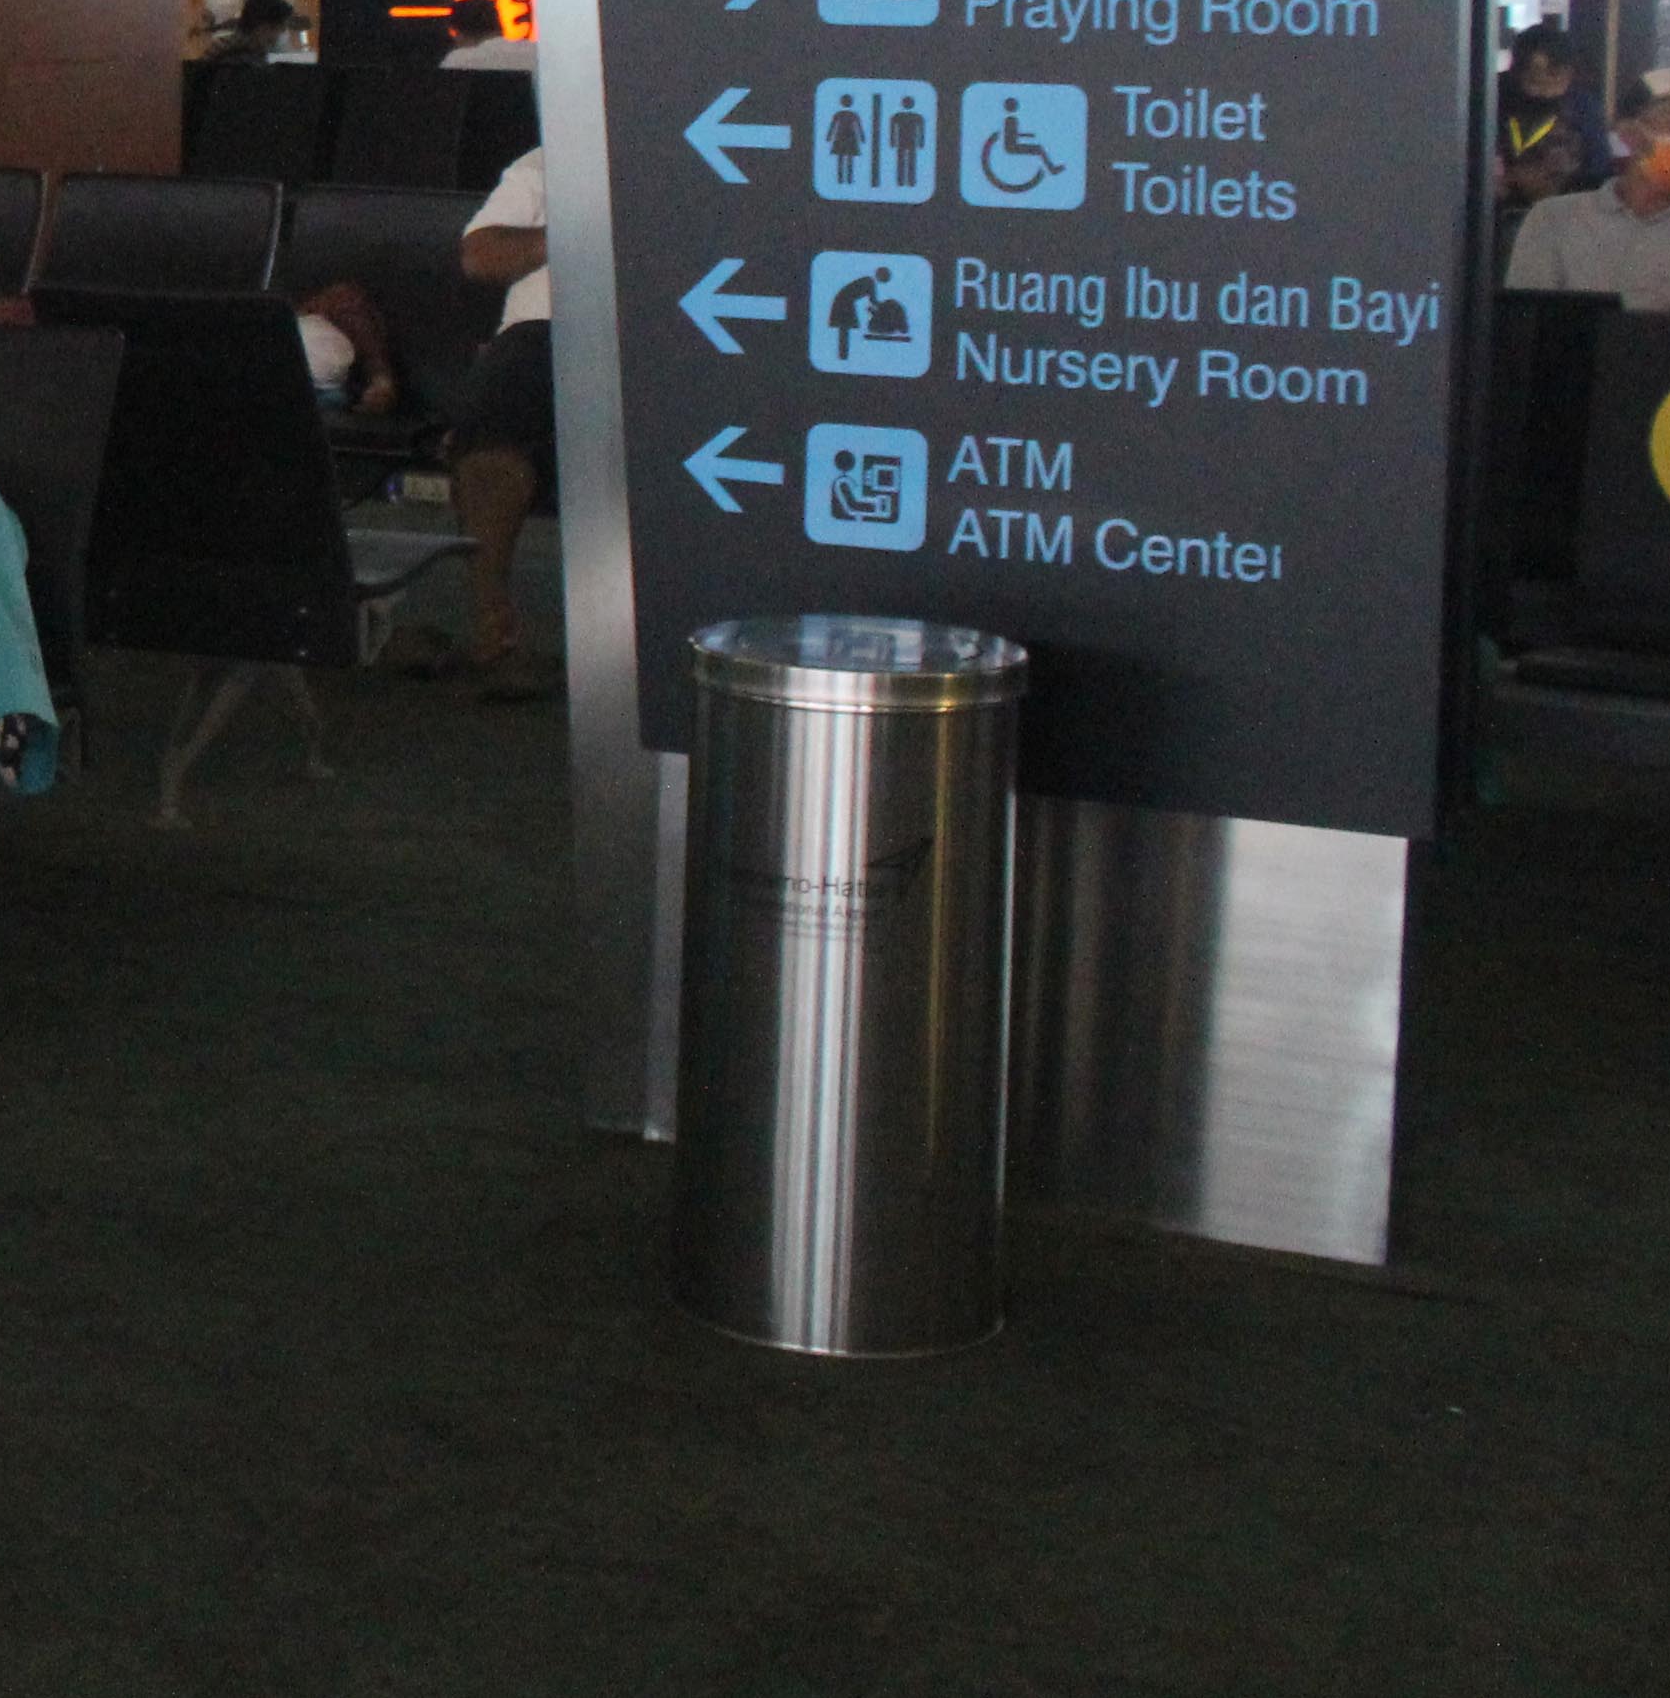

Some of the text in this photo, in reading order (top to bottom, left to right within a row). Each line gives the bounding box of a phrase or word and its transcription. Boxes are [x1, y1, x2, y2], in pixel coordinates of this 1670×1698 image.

[1113, 85, 1265, 141] Toilet
[1112, 162, 1296, 220] Toilets
[954, 257, 1439, 346] Ruang Ibu dan Bayi
[957, 332, 1367, 407] Nursery Room
[948, 436, 1072, 490] ATM
[948, 509, 1281, 582] ATM Center
